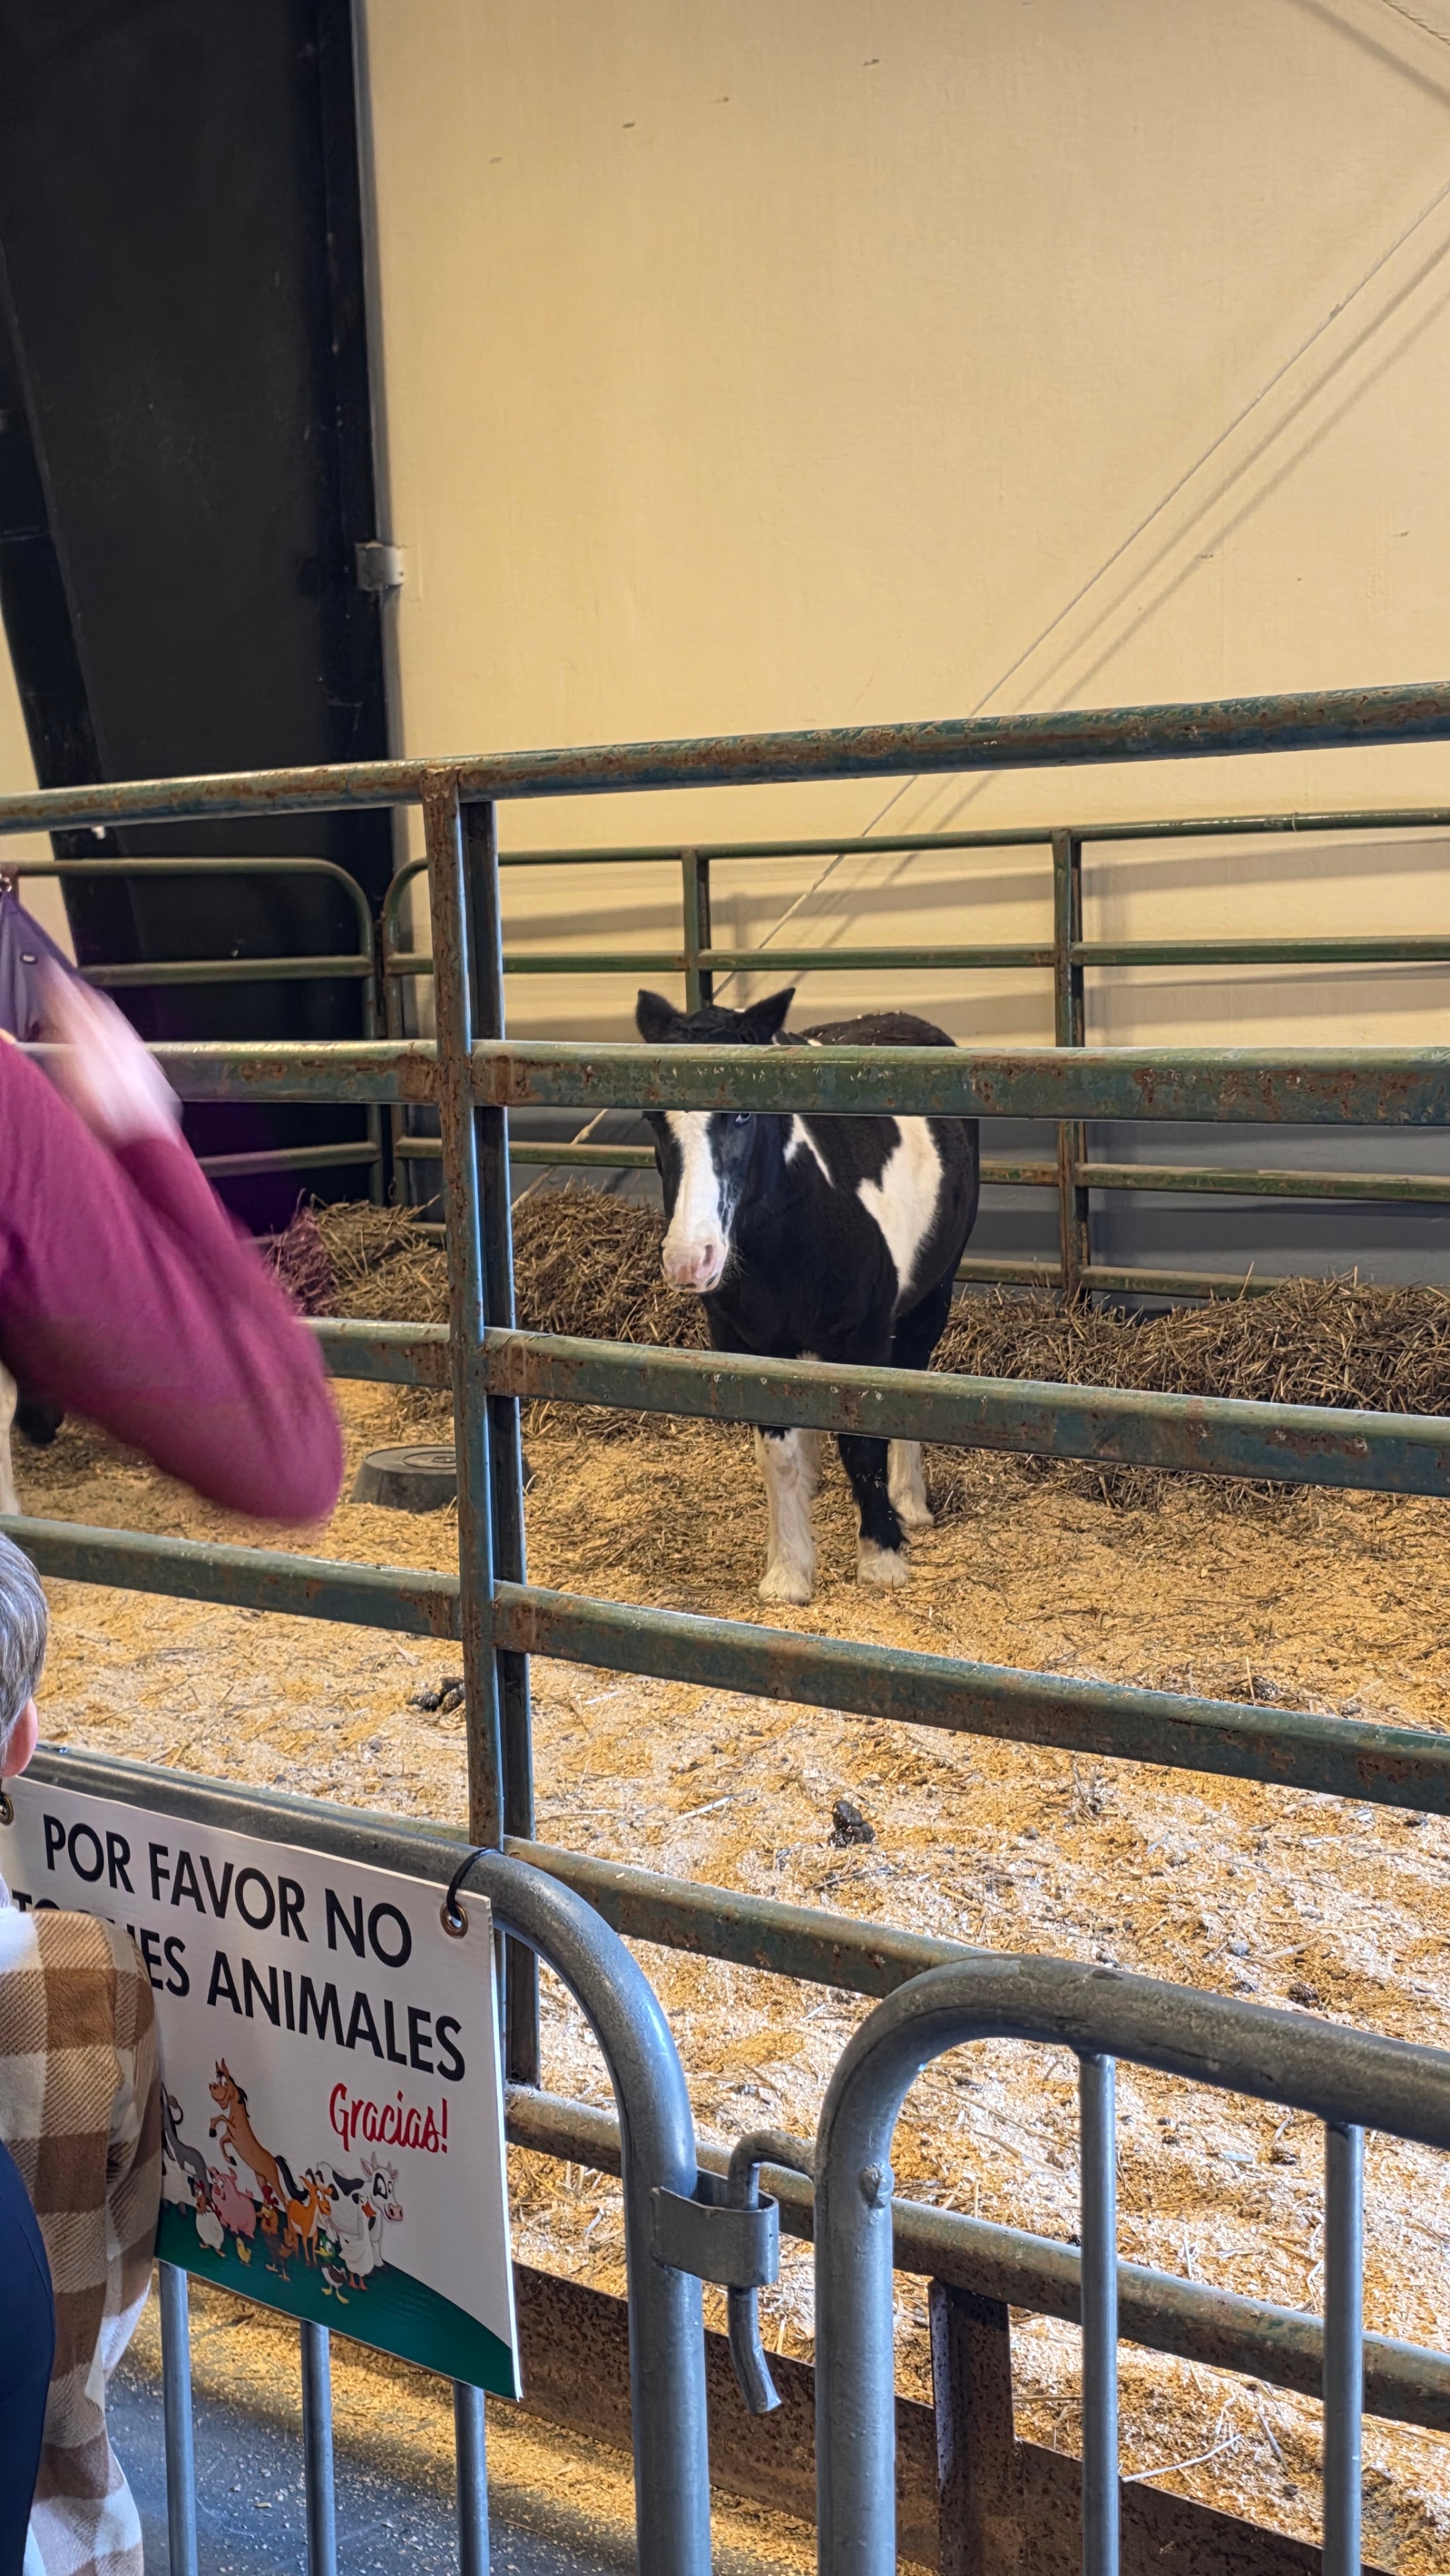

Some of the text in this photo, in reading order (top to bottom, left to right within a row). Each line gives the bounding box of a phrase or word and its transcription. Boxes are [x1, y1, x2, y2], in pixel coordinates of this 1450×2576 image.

[43, 1813, 412, 1968] POR FAVOR NO
[207, 1950, 465, 2082] ANIMALES
[330, 2082, 449, 2153] Gracias!
